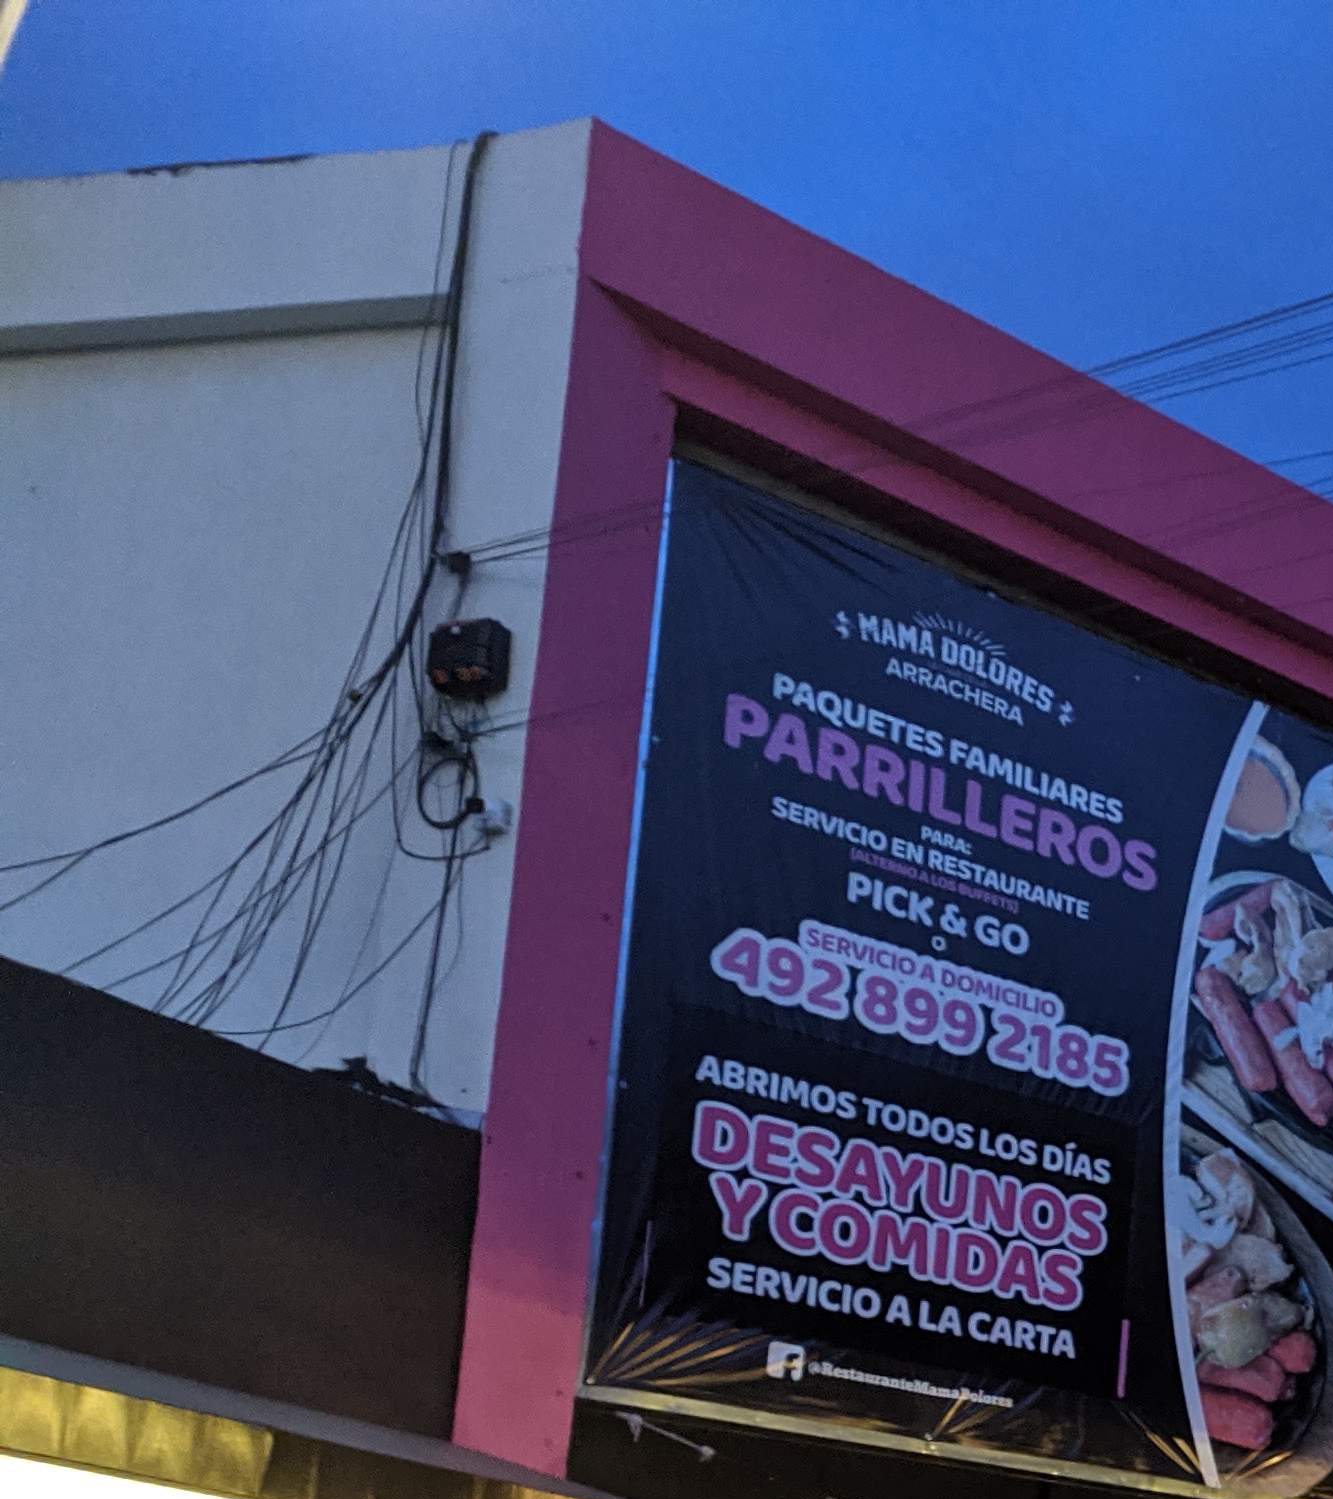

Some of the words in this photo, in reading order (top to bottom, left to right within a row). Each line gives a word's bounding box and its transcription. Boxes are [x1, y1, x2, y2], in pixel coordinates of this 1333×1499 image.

[885, 656, 1024, 727] ARRACHERA
[940, 636, 1055, 713] DOLORES
[723, 693, 1158, 891] PARRILLEROS
[772, 671, 944, 758] PAQUETES
[949, 738, 1124, 825] FAMILIARES
[770, 796, 888, 851] SERVICIO
[890, 836, 925, 866] EN
[927, 848, 1090, 921] RESTAURANTE
[920, 825, 973, 856] PARA:
[806, 927, 917, 976] SERVICIO
[919, 963, 936, 983] A
[940, 968, 1058, 1019] DOMICILIO
[847, 871, 934, 928] PICK
[938, 902, 968, 938] &
[974, 914, 1031, 956] GO
[715, 932, 846, 1015] 492
[859, 972, 980, 1050] 899
[990, 1011, 1126, 1091] 2185
[695, 1054, 857, 1120] ABRIMOS
[861, 1097, 975, 1150] TODOS
[978, 1127, 1039, 1167] LOS
[1042, 1141, 1112, 1185] DÍAS
[695, 1103, 1105, 1253] DESAYUNOS
[713, 1173, 766, 1237] Y
[772, 1190, 1082, 1309] COMIDAS
[706, 1256, 883, 1319] SERVICIO
[885, 1294, 913, 1328] A
[918, 1300, 963, 1337] LA
[967, 1311, 1077, 1360] CARTA
